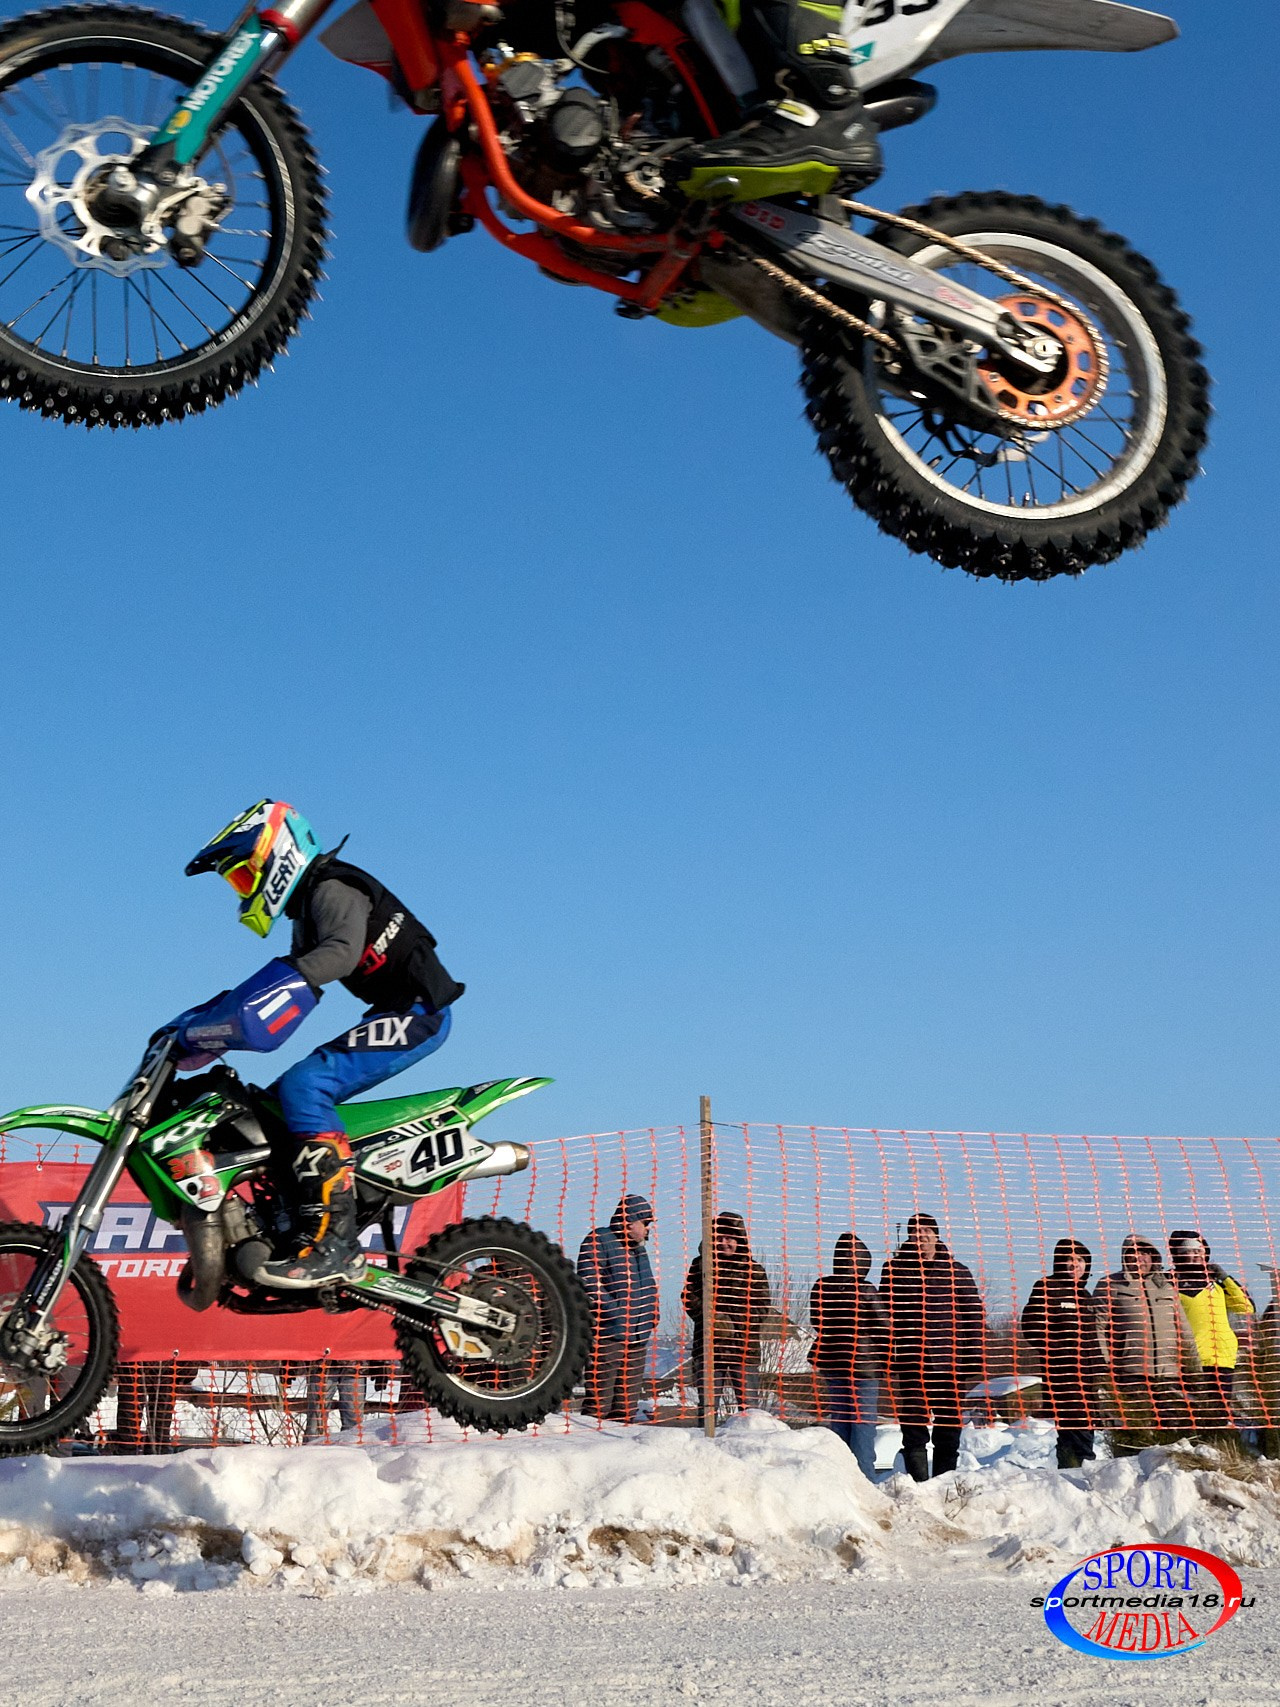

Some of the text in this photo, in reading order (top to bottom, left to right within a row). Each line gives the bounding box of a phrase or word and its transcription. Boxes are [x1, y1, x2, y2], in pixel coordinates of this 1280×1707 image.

[183, 30, 261, 111] MOTOREX
[348, 1016, 413, 1047] FOX
[410, 1128, 464, 1173] 40
